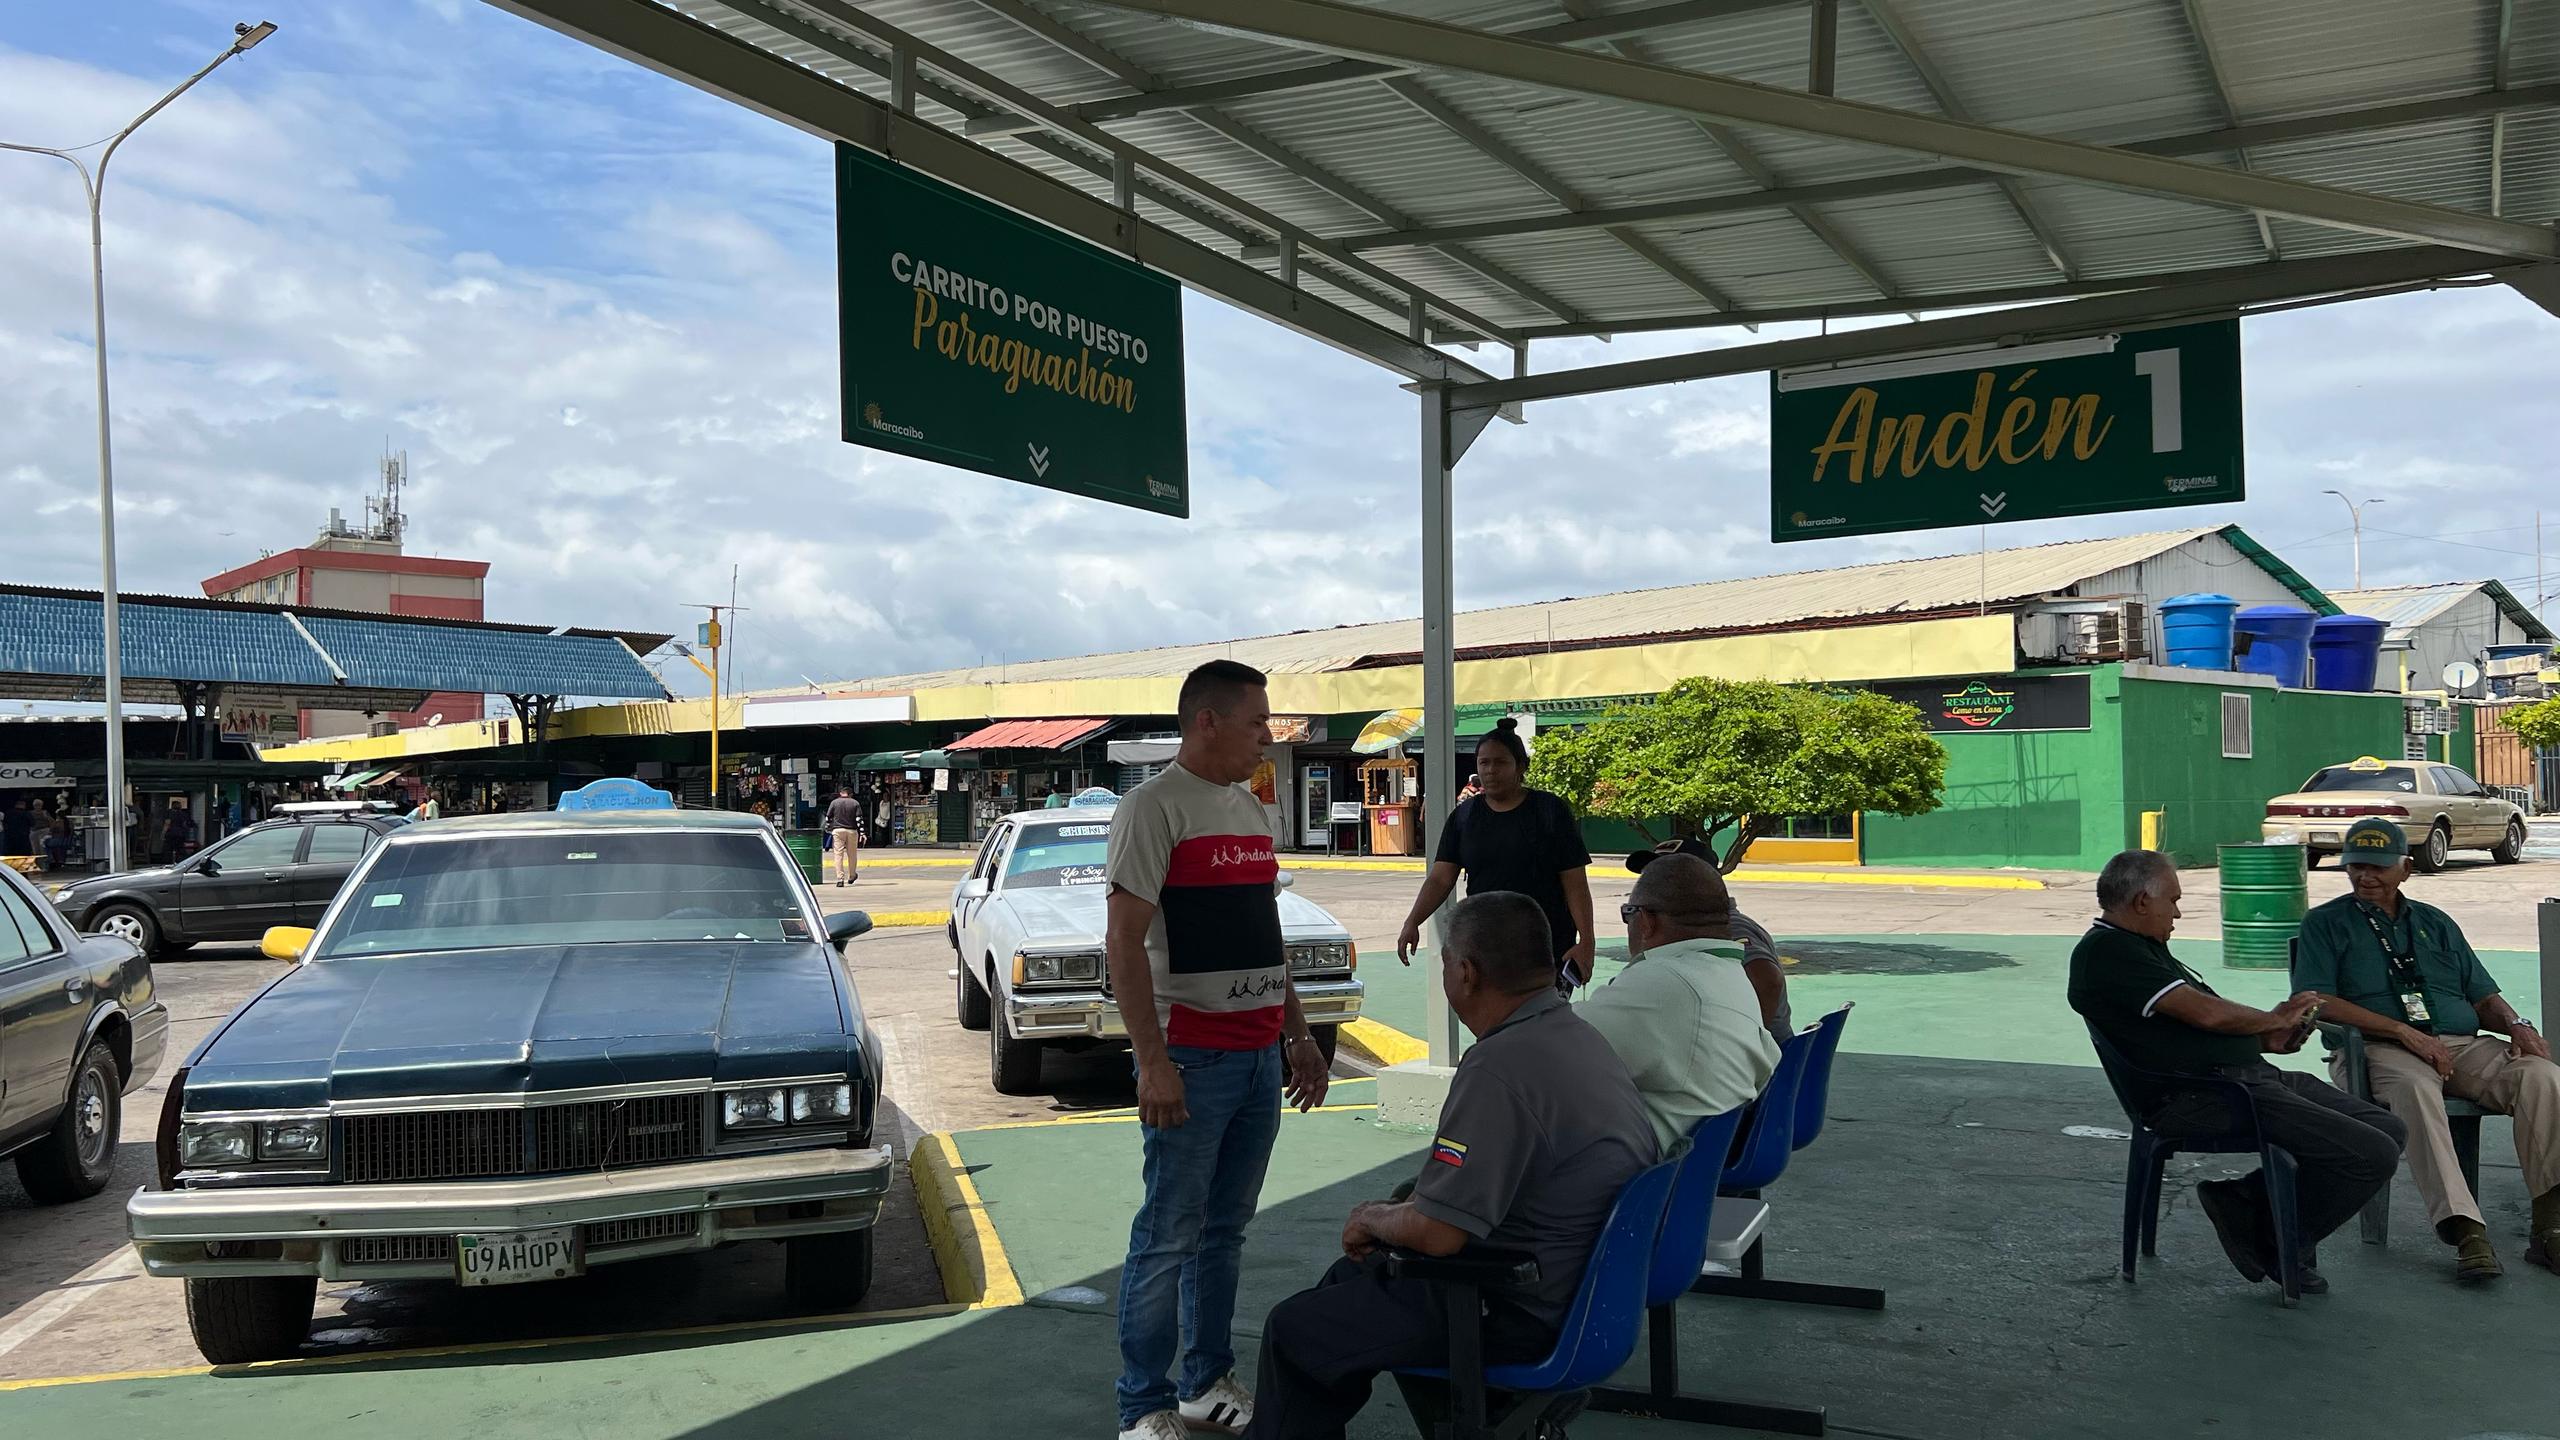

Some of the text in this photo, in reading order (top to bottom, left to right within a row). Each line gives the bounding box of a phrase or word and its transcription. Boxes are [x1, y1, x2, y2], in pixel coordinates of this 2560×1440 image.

[891, 251, 1148, 364] CARRITO POR PUESTO
[912, 287, 1137, 414] Paraguachón
[1811, 346, 2182, 484] Andén 1
[873, 418, 924, 440] Maracaibo
[1149, 479, 1180, 497] TERMINAL
[2167, 475, 2218, 488] TERMINAL
[1798, 516, 1847, 528] Maracaibo
[1946, 696, 2010, 707] RESTAURANT
[1952, 706, 1972, 714] Como
[1984, 705, 2002, 713] Casa
[0, 763, 56, 779] enez
[2356, 838, 2384, 848] TAXI
[1233, 845, 1274, 865] Jordan
[1060, 866, 1104, 879] Yo Soy
[628, 1122, 685, 1136] CHEVROLET
